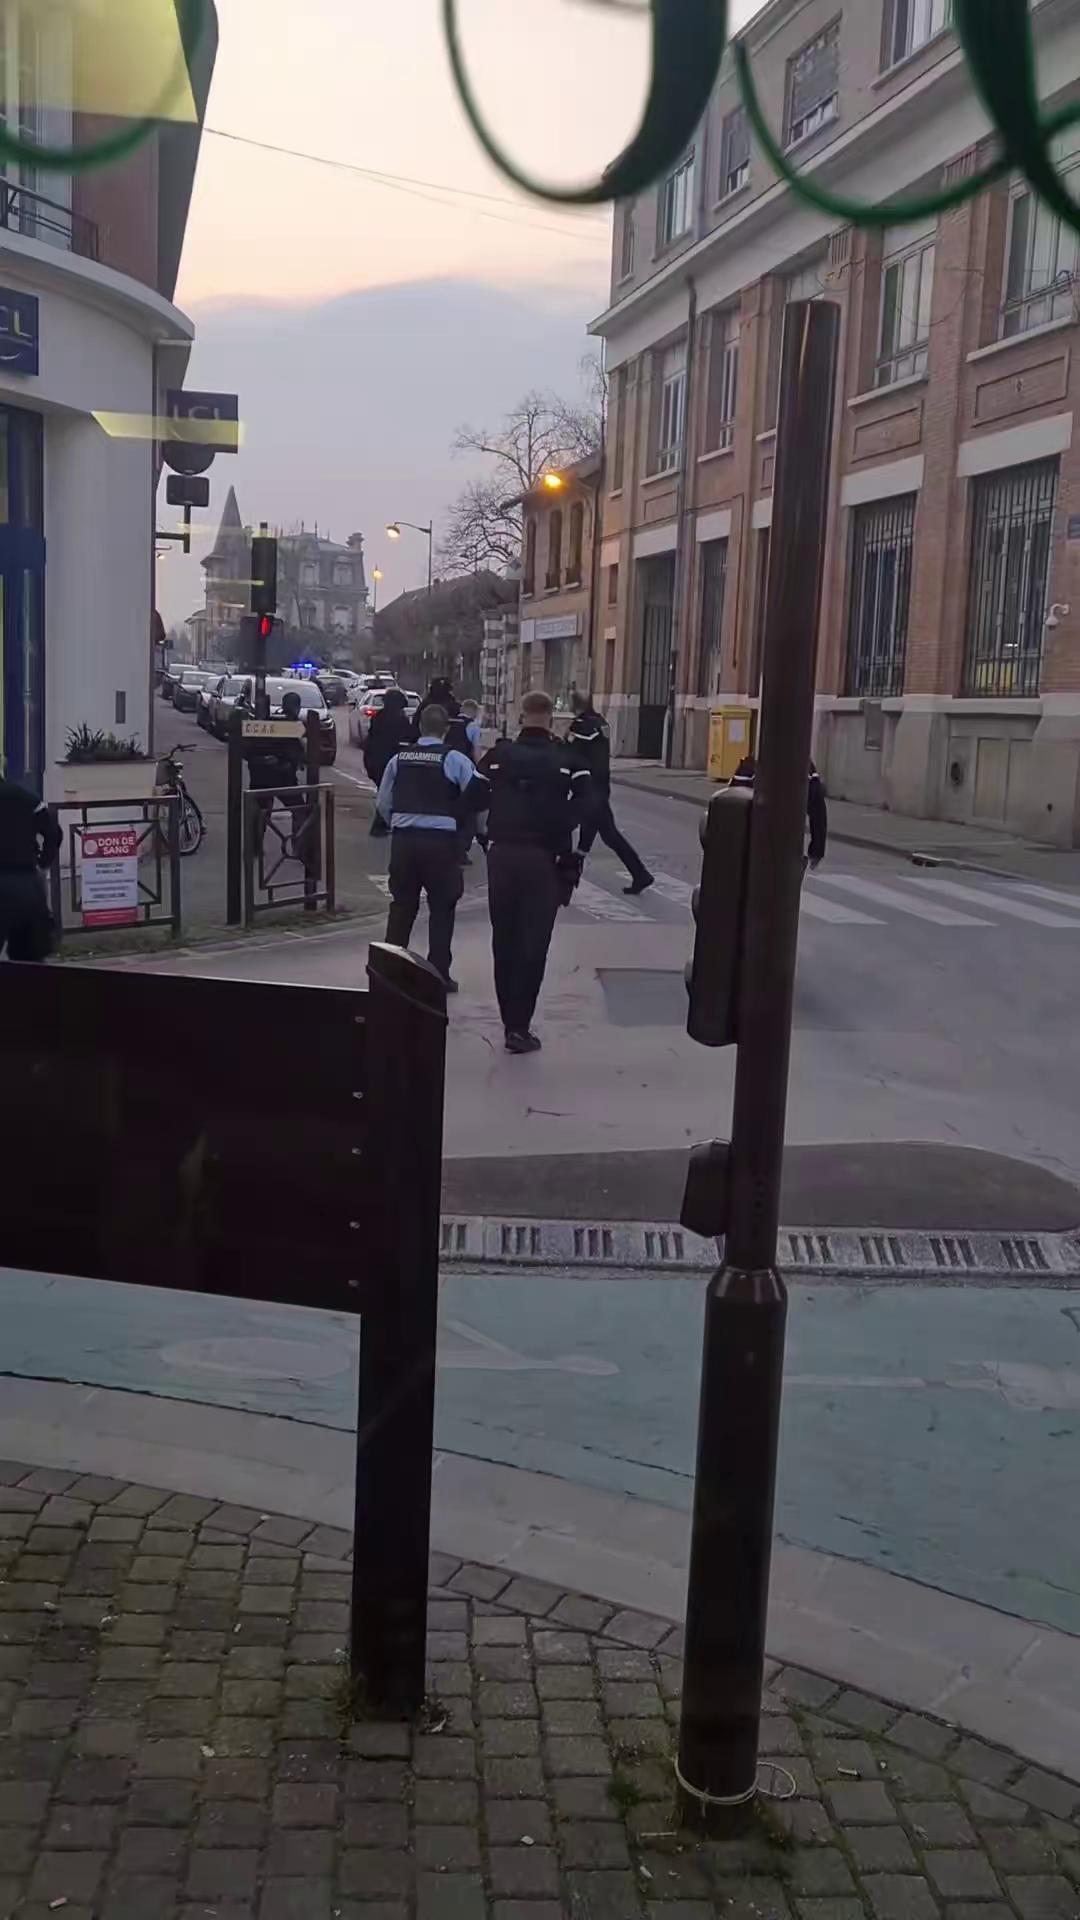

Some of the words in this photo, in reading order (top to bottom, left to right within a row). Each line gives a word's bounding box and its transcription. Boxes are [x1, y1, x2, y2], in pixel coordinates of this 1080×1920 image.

[399, 751, 442, 761] GENDARMERIE
[98, 838, 119, 847] DON
[122, 836, 135, 845] DE
[103, 846, 129, 855] SANG
